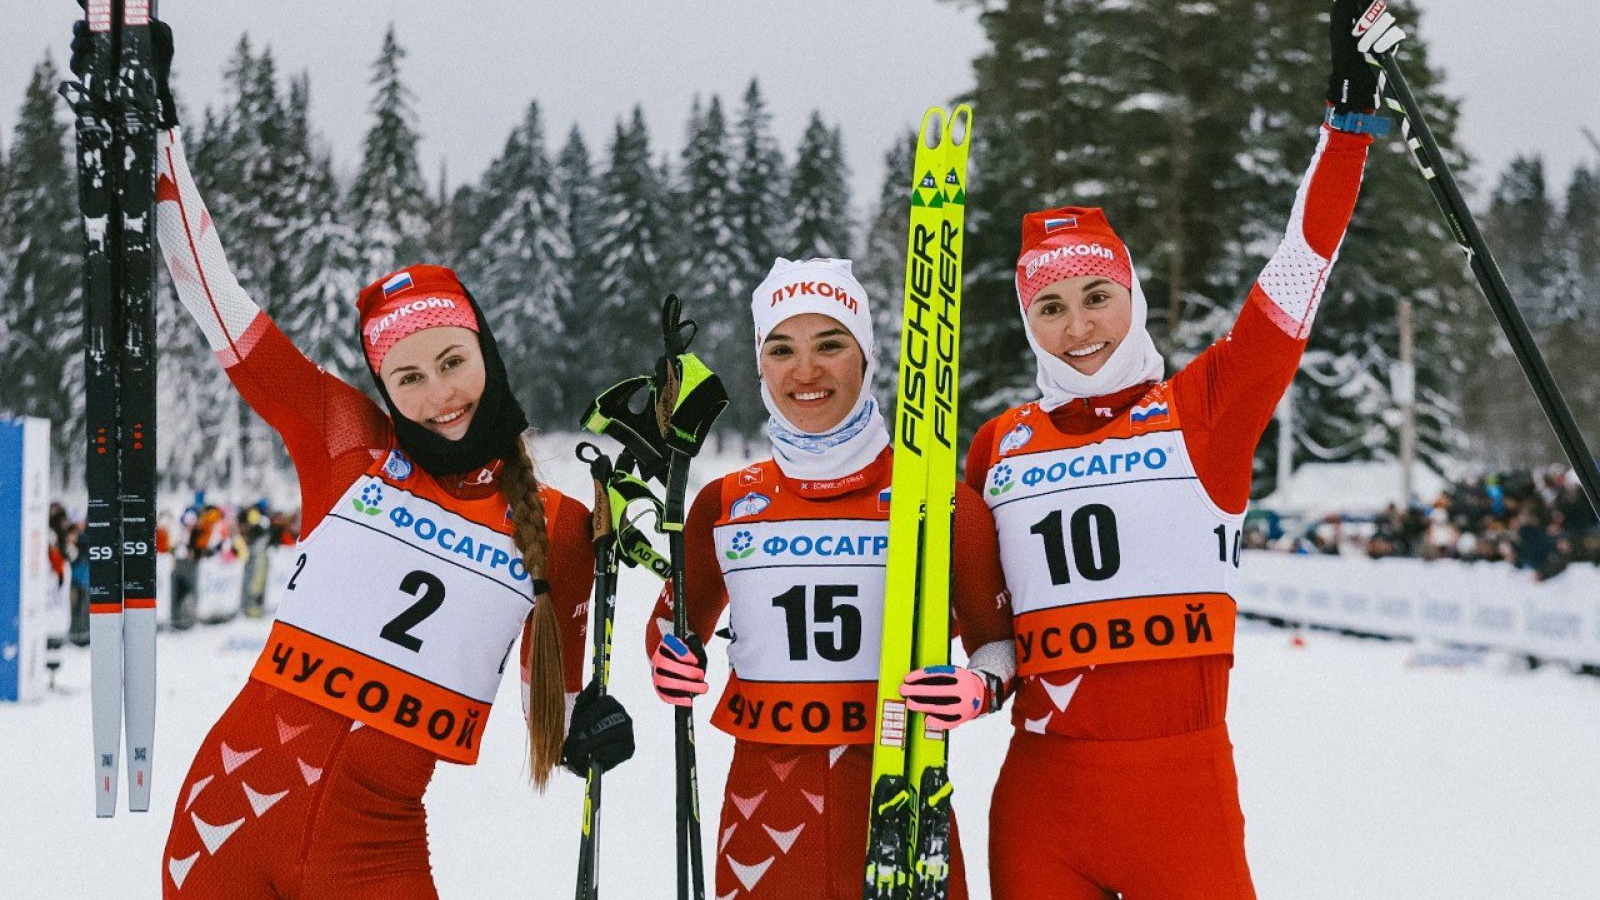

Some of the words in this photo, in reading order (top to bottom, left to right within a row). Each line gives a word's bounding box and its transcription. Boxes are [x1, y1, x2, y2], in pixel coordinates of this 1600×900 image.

[1039, 243, 1115, 267] ЛУКОЙЛ
[379, 296, 456, 332] ЛУКОЙЛ
[771, 281, 859, 315] ЛУКОЙЛ
[902, 223, 935, 457] FISCHER
[934, 219, 959, 450] FISCHER
[1022, 447, 1167, 487] ФОСАГРО
[389, 506, 529, 582] ФОСАГРО
[763, 535, 889, 556] ФОСАГР
[1030, 503, 1121, 586] 10
[1213, 523, 1241, 569] 10
[287, 552, 307, 590] 2
[379, 570, 446, 653] 2
[772, 584, 862, 662] 15
[1017, 602, 1213, 663] УСОВОЙ
[271, 641, 482, 750] ЧУСОВОЙ
[728, 693, 867, 733] ЧУСОВ
